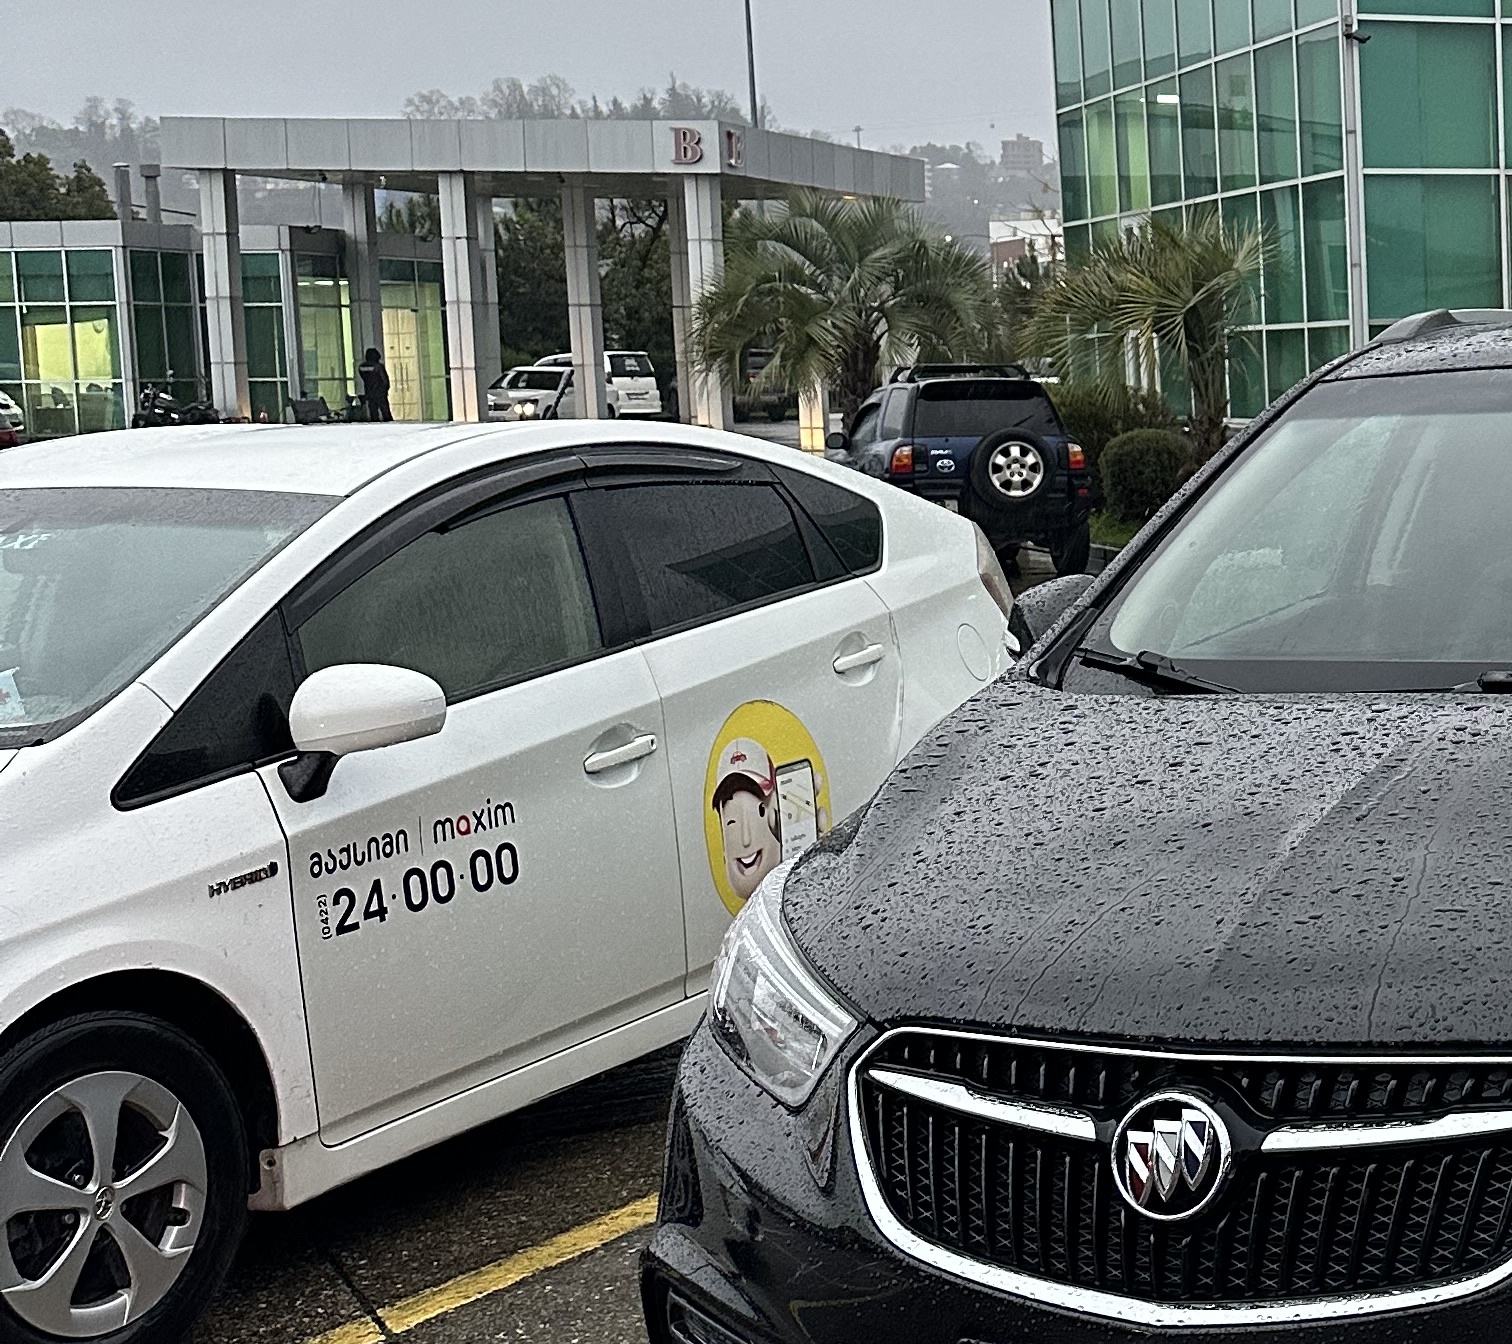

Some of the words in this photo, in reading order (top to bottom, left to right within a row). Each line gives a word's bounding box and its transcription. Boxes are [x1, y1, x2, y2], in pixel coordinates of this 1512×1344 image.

[670, 126, 703, 165] B
[433, 798, 516, 844] maxim
[316, 894, 333, 940] (0422)
